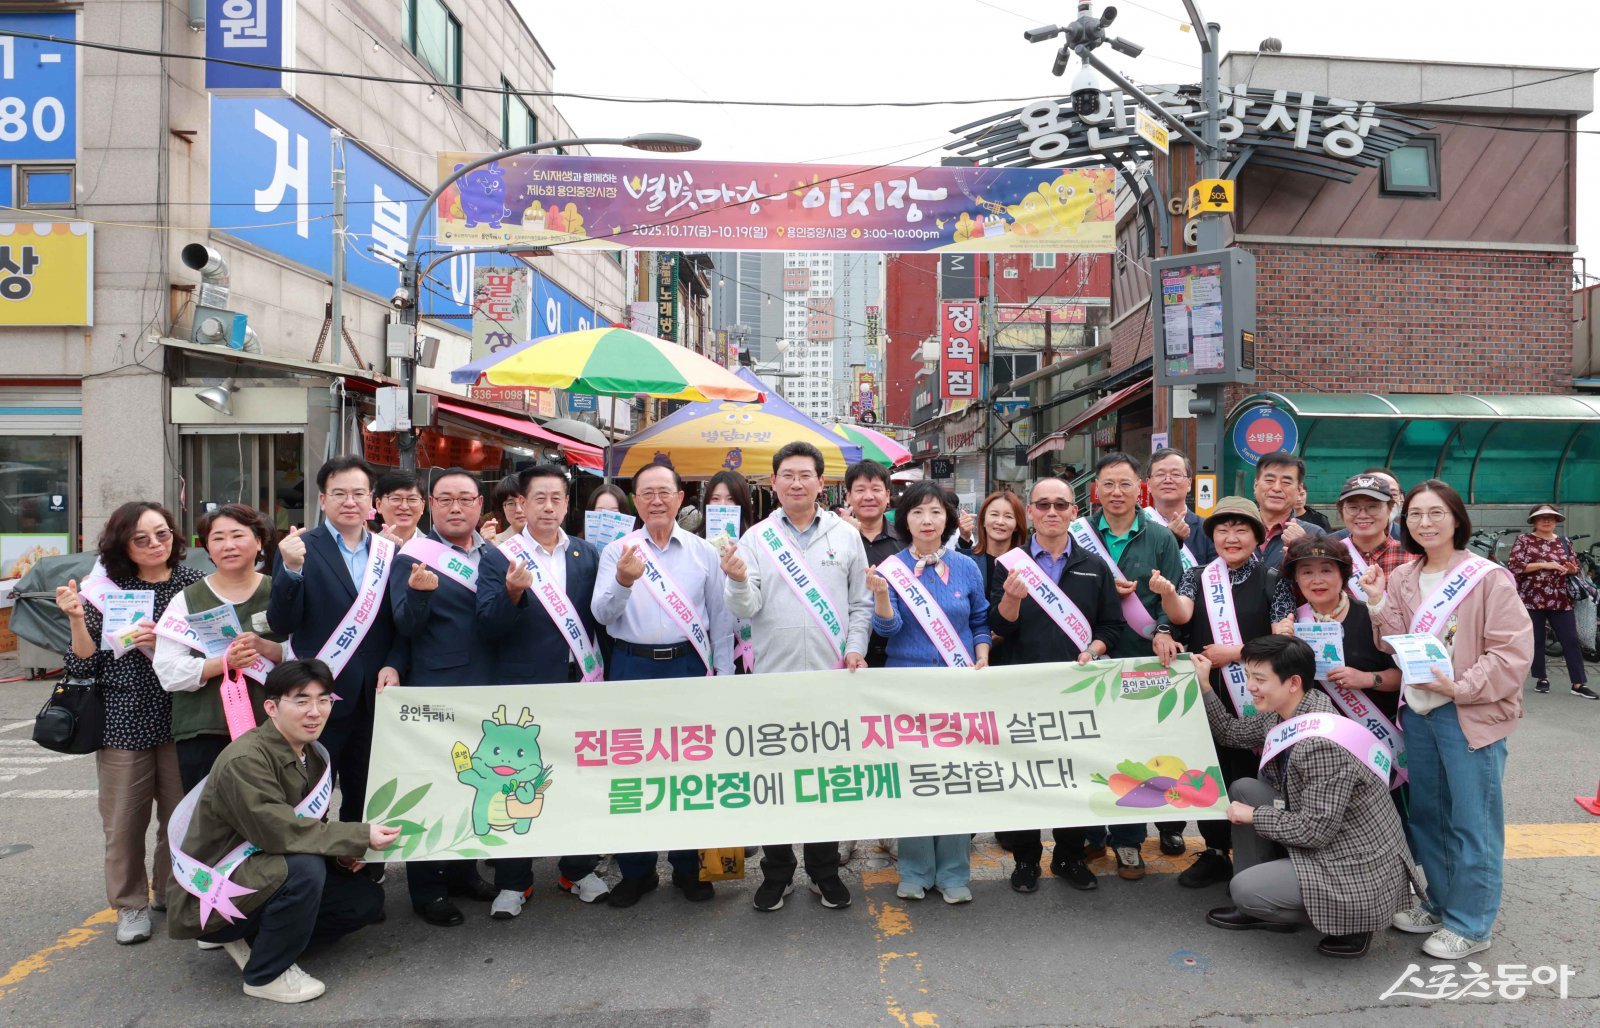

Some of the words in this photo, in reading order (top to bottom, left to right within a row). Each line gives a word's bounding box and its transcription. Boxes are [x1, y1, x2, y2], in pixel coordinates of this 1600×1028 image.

[527, 184, 556, 197] 제6회
[557, 185, 618, 199] 용인중앙시장
[533, 170, 582, 183] 도시재생과
[583, 172, 618, 184] 함께하는
[623, 173, 772, 217] 별빛마당
[801, 176, 948, 223] 야시장
[787, 227, 847, 239] 용인중앙시장
[863, 229, 940, 241] 3:00-10:00pm
[660, 286, 672, 333] 노래방
[947, 305, 974, 397] 정육점
[473, 389, 523, 400] 336-1098
[1248, 433, 1283, 443] 소방용수
[447, 558, 475, 580] 함께
[762, 528, 783, 552] 함께
[778, 551, 810, 588] 만드는
[805, 588, 841, 636] 물가안정
[354, 589, 377, 625] 건전한
[541, 583, 568, 617] 건전한
[564, 618, 584, 650] 소비!
[665, 592, 694, 625] 건전한
[330, 625, 358, 658] 소비!
[930, 619, 957, 653] 건전한
[1064, 613, 1090, 643] 건전한
[1228, 662, 1246, 696] 소비!
[399, 704, 455, 722] 용인특례시
[574, 724, 717, 767] 전통시장
[725, 717, 851, 758] 이용하여
[860, 710, 1000, 751] 지역경제
[1006, 710, 1101, 744] 살리고
[1366, 718, 1394, 749] 소비!
[608, 766, 785, 814] 물가안정에
[795, 762, 902, 804] 다함께
[908, 758, 1079, 797] 동참합시다!
